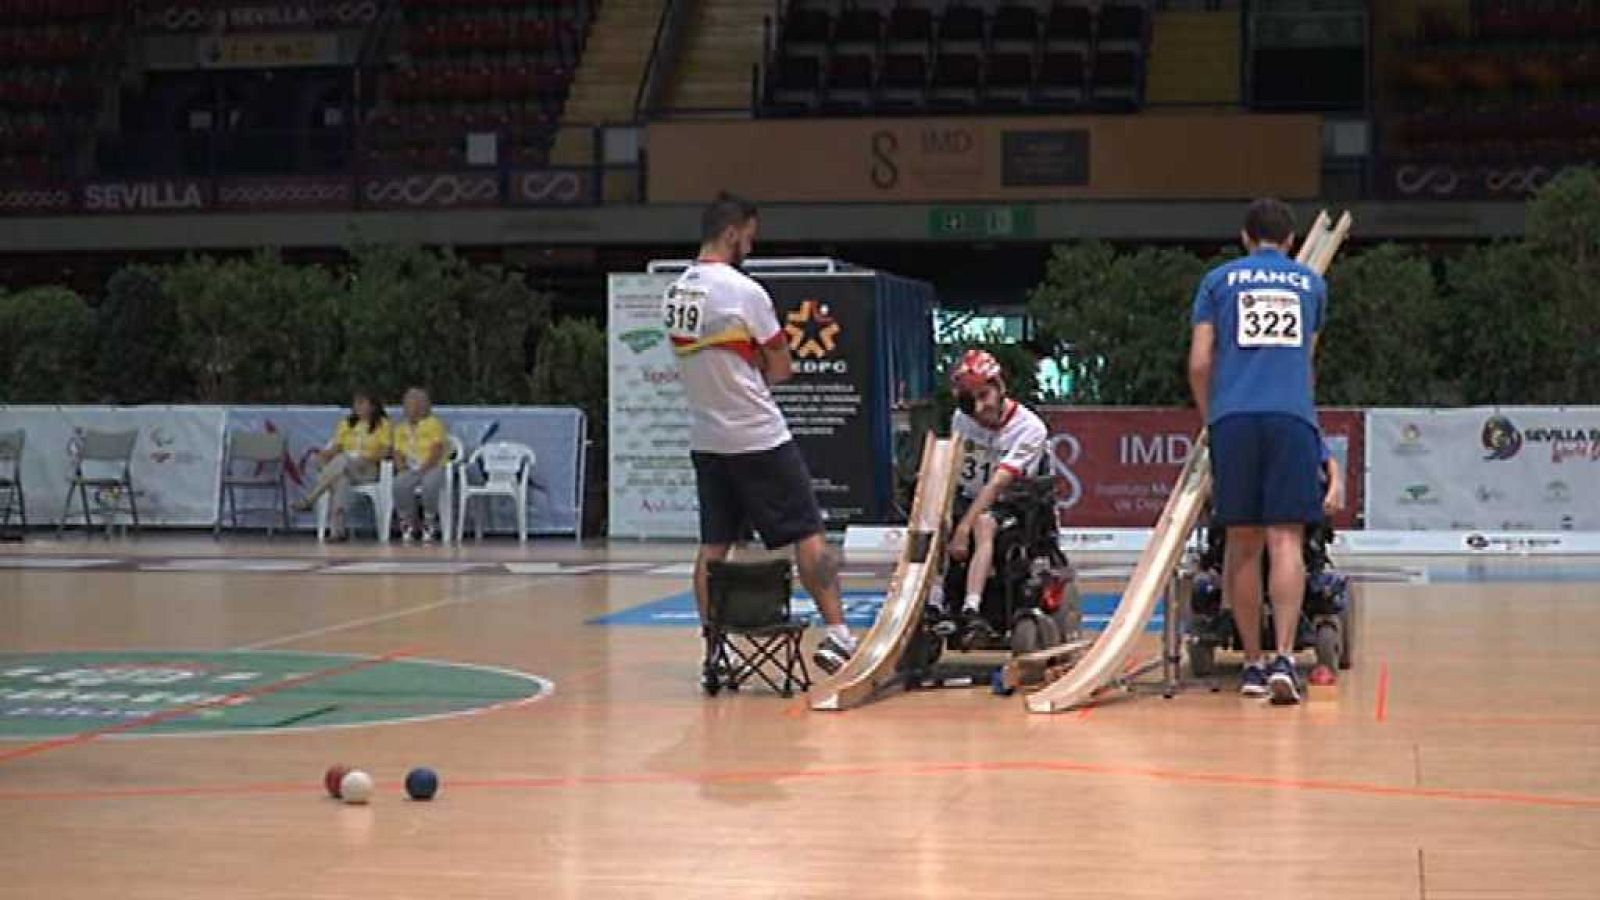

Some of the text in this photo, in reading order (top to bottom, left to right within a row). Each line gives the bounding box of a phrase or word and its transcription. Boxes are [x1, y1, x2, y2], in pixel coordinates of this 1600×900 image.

[921, 129, 974, 154] IMD
[85, 182, 201, 209] SEVILLA
[1227, 268, 1312, 290] FRANCE
[664, 303, 699, 331] 319
[1243, 310, 1297, 338] 322
[1525, 427, 1586, 442] SEVILLA
[1119, 434, 1193, 464] IMD
[961, 456, 992, 483] 31
